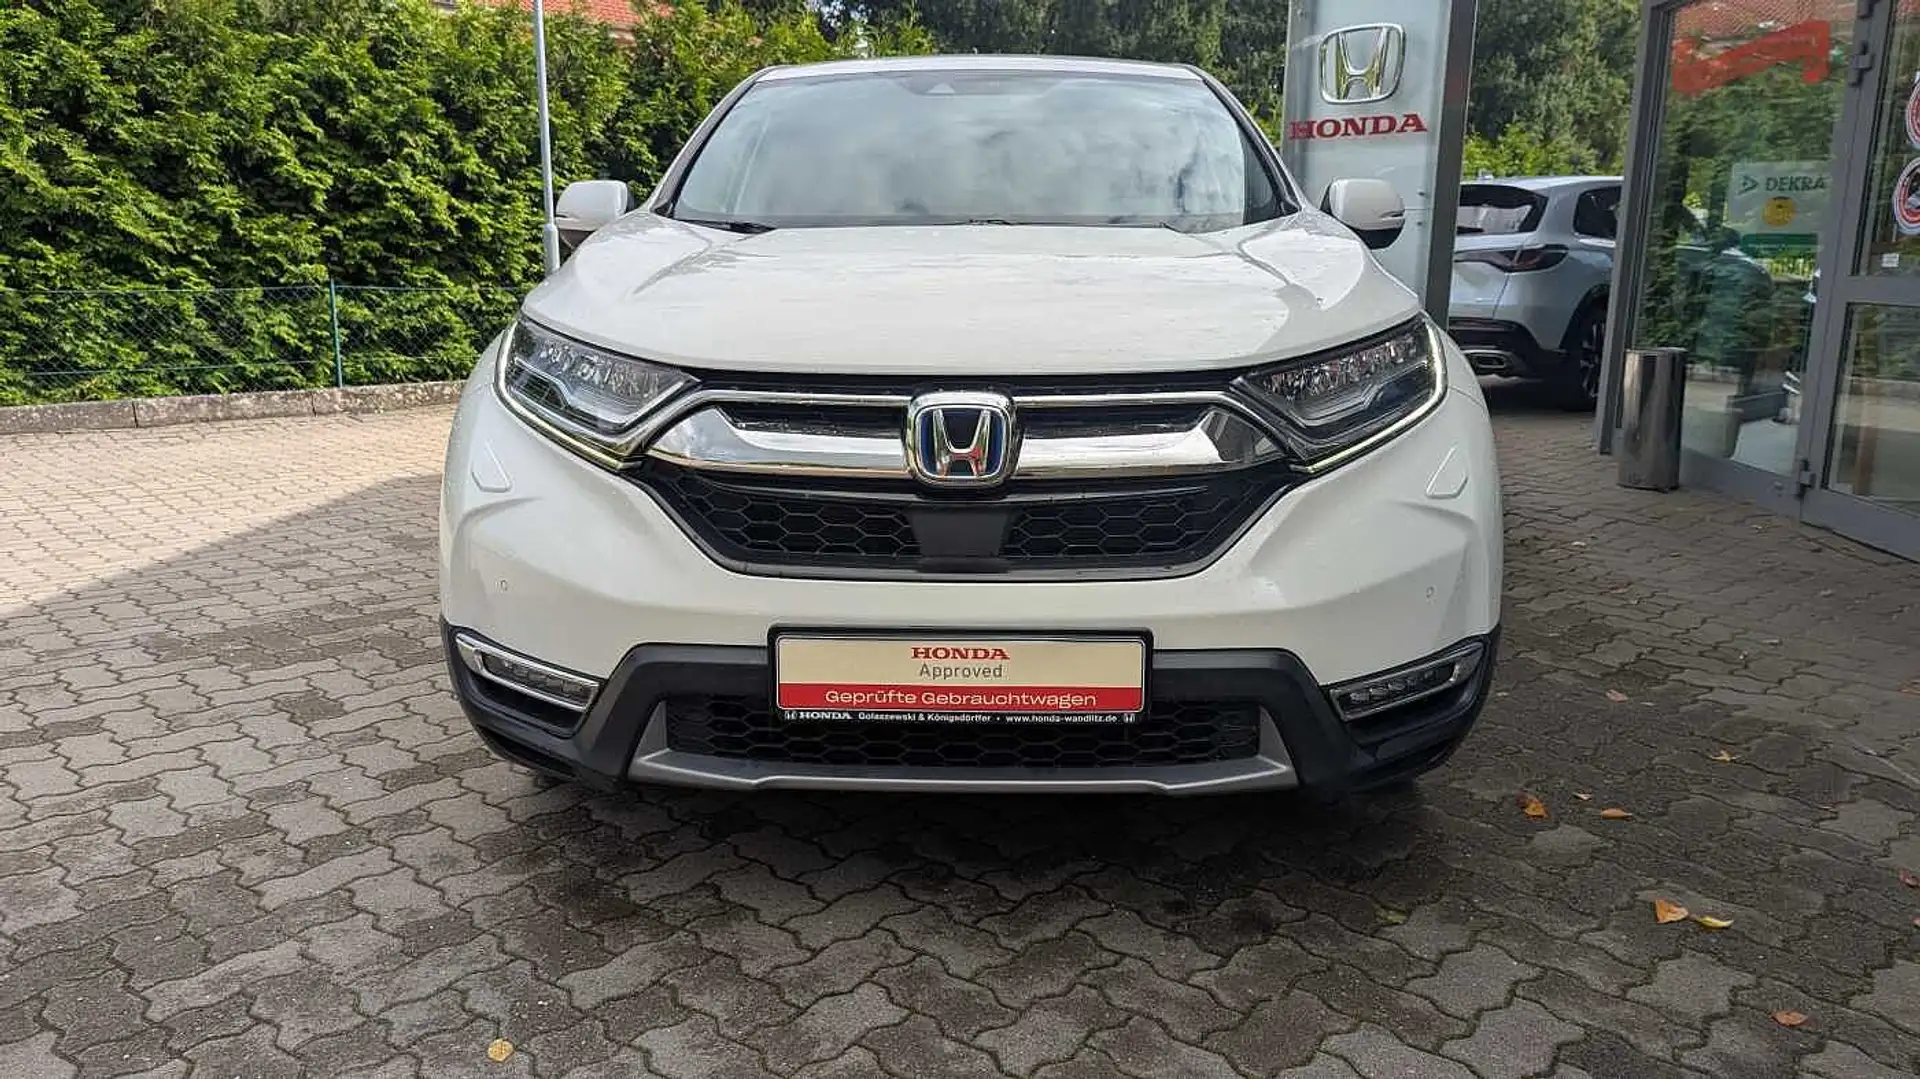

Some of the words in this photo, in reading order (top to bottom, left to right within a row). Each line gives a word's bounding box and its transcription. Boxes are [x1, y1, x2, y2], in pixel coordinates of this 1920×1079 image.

[1289, 112, 1428, 141] HONDA
[1765, 175, 1826, 192] DEKRA
[911, 647, 1010, 660] HONDA
[919, 664, 1003, 680] Approved
[825, 690, 917, 706] Geprüfte
[921, 692, 1097, 709] Gebrauchtwagen
[799, 711, 852, 720] HONDA
